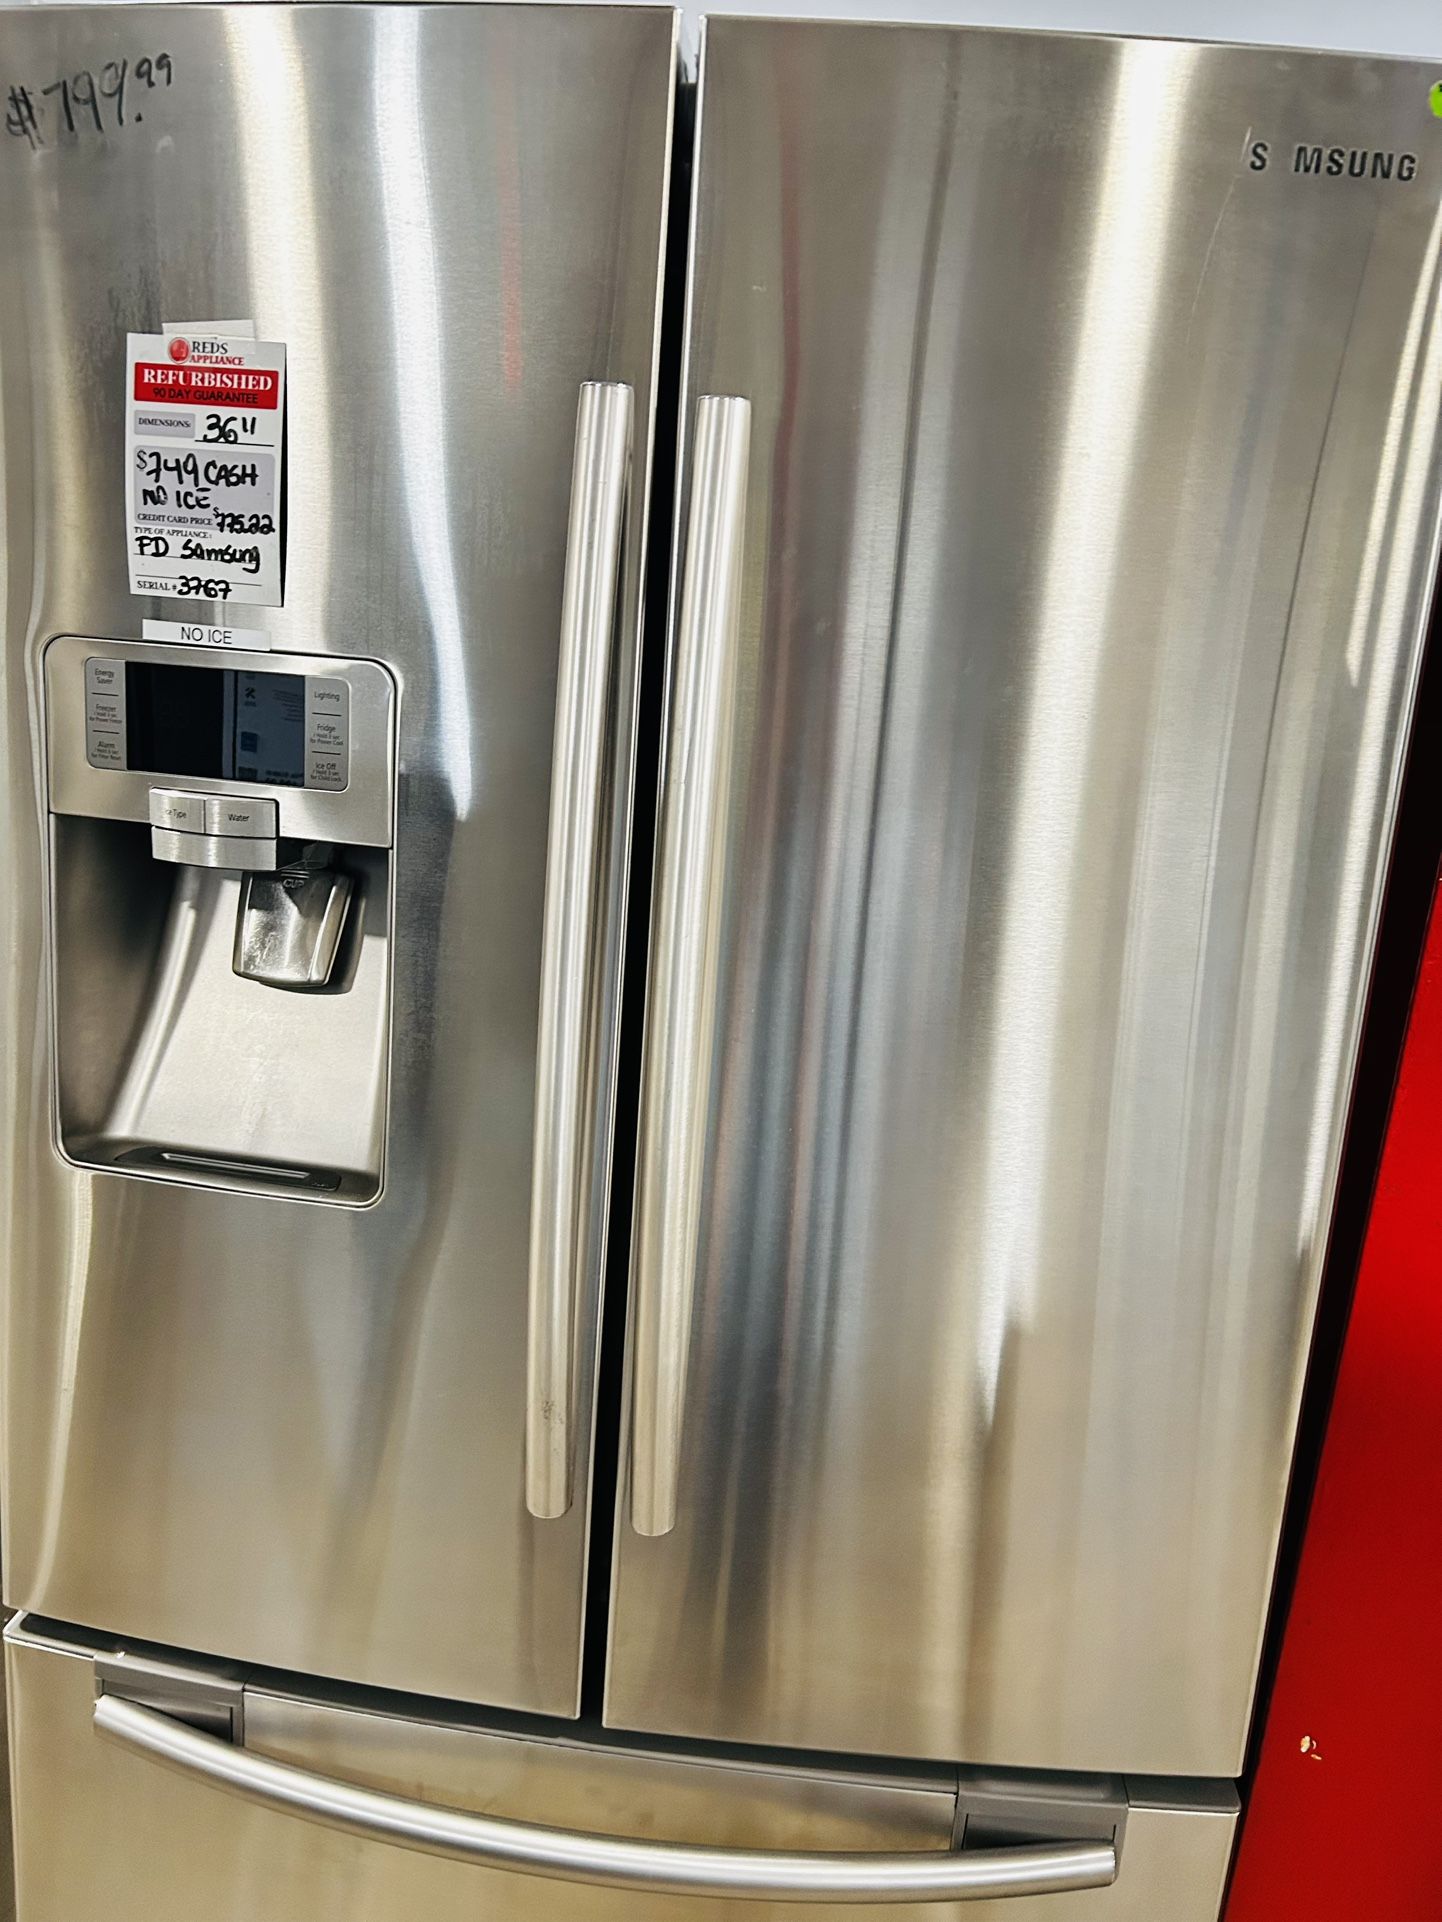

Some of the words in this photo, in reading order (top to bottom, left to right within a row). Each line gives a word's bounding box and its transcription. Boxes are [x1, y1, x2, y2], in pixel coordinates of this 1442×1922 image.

[191, 341, 228, 354] REDS
[189, 355, 244, 366] APPLIANCE
[143, 368, 272, 390] REFURBISHED
[152, 388, 166, 398] 90
[168, 389, 191, 400] DAY
[193, 391, 258, 404] GUARANTEE
[138, 417, 191, 428] DIMENSIONS:
[136, 450, 199, 487] $749
[204, 460, 259, 487] CASH
[142, 485, 168, 506] NO
[176, 487, 211, 509] ICE
[137, 513, 165, 522] CREDIT
[167, 516, 188, 524] CARD
[190, 517, 213, 526] PRICE
[134, 526, 153, 535] TYPE
[137, 581, 170, 591] SERIAL
[177, 575, 232, 600] 3767
[181, 626, 203, 641] NO
[208, 629, 232, 645] ICE
[314, 691, 340, 702] Lighting
[317, 723, 336, 733] Fridge
[173, 808, 187, 819] Type
[228, 813, 250, 822] Water
[283, 878, 304, 888] CUP
